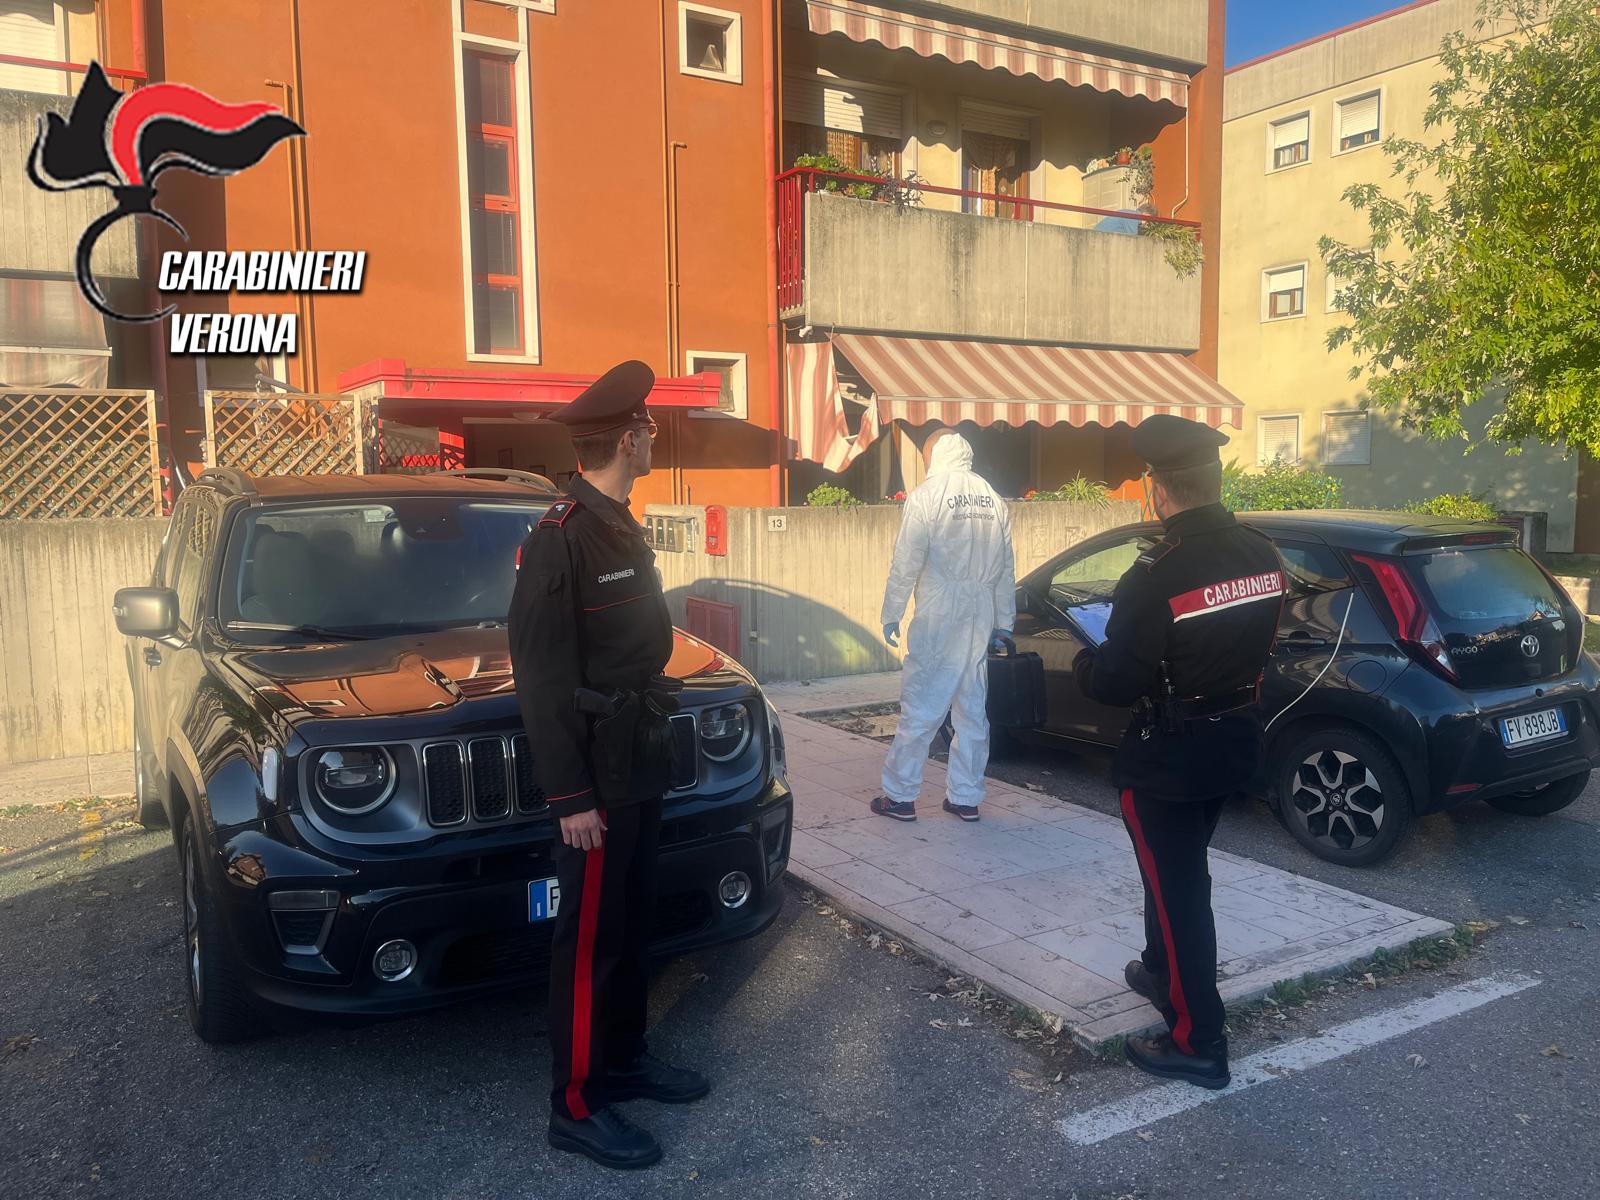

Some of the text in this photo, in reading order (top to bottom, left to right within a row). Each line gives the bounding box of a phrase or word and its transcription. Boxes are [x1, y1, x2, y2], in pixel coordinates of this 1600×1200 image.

[772, 518, 783, 528] 13
[597, 568, 635, 584] CARABINIERI
[1203, 573, 1281, 606] CARABINIERI
[1506, 719, 1522, 741] FV
